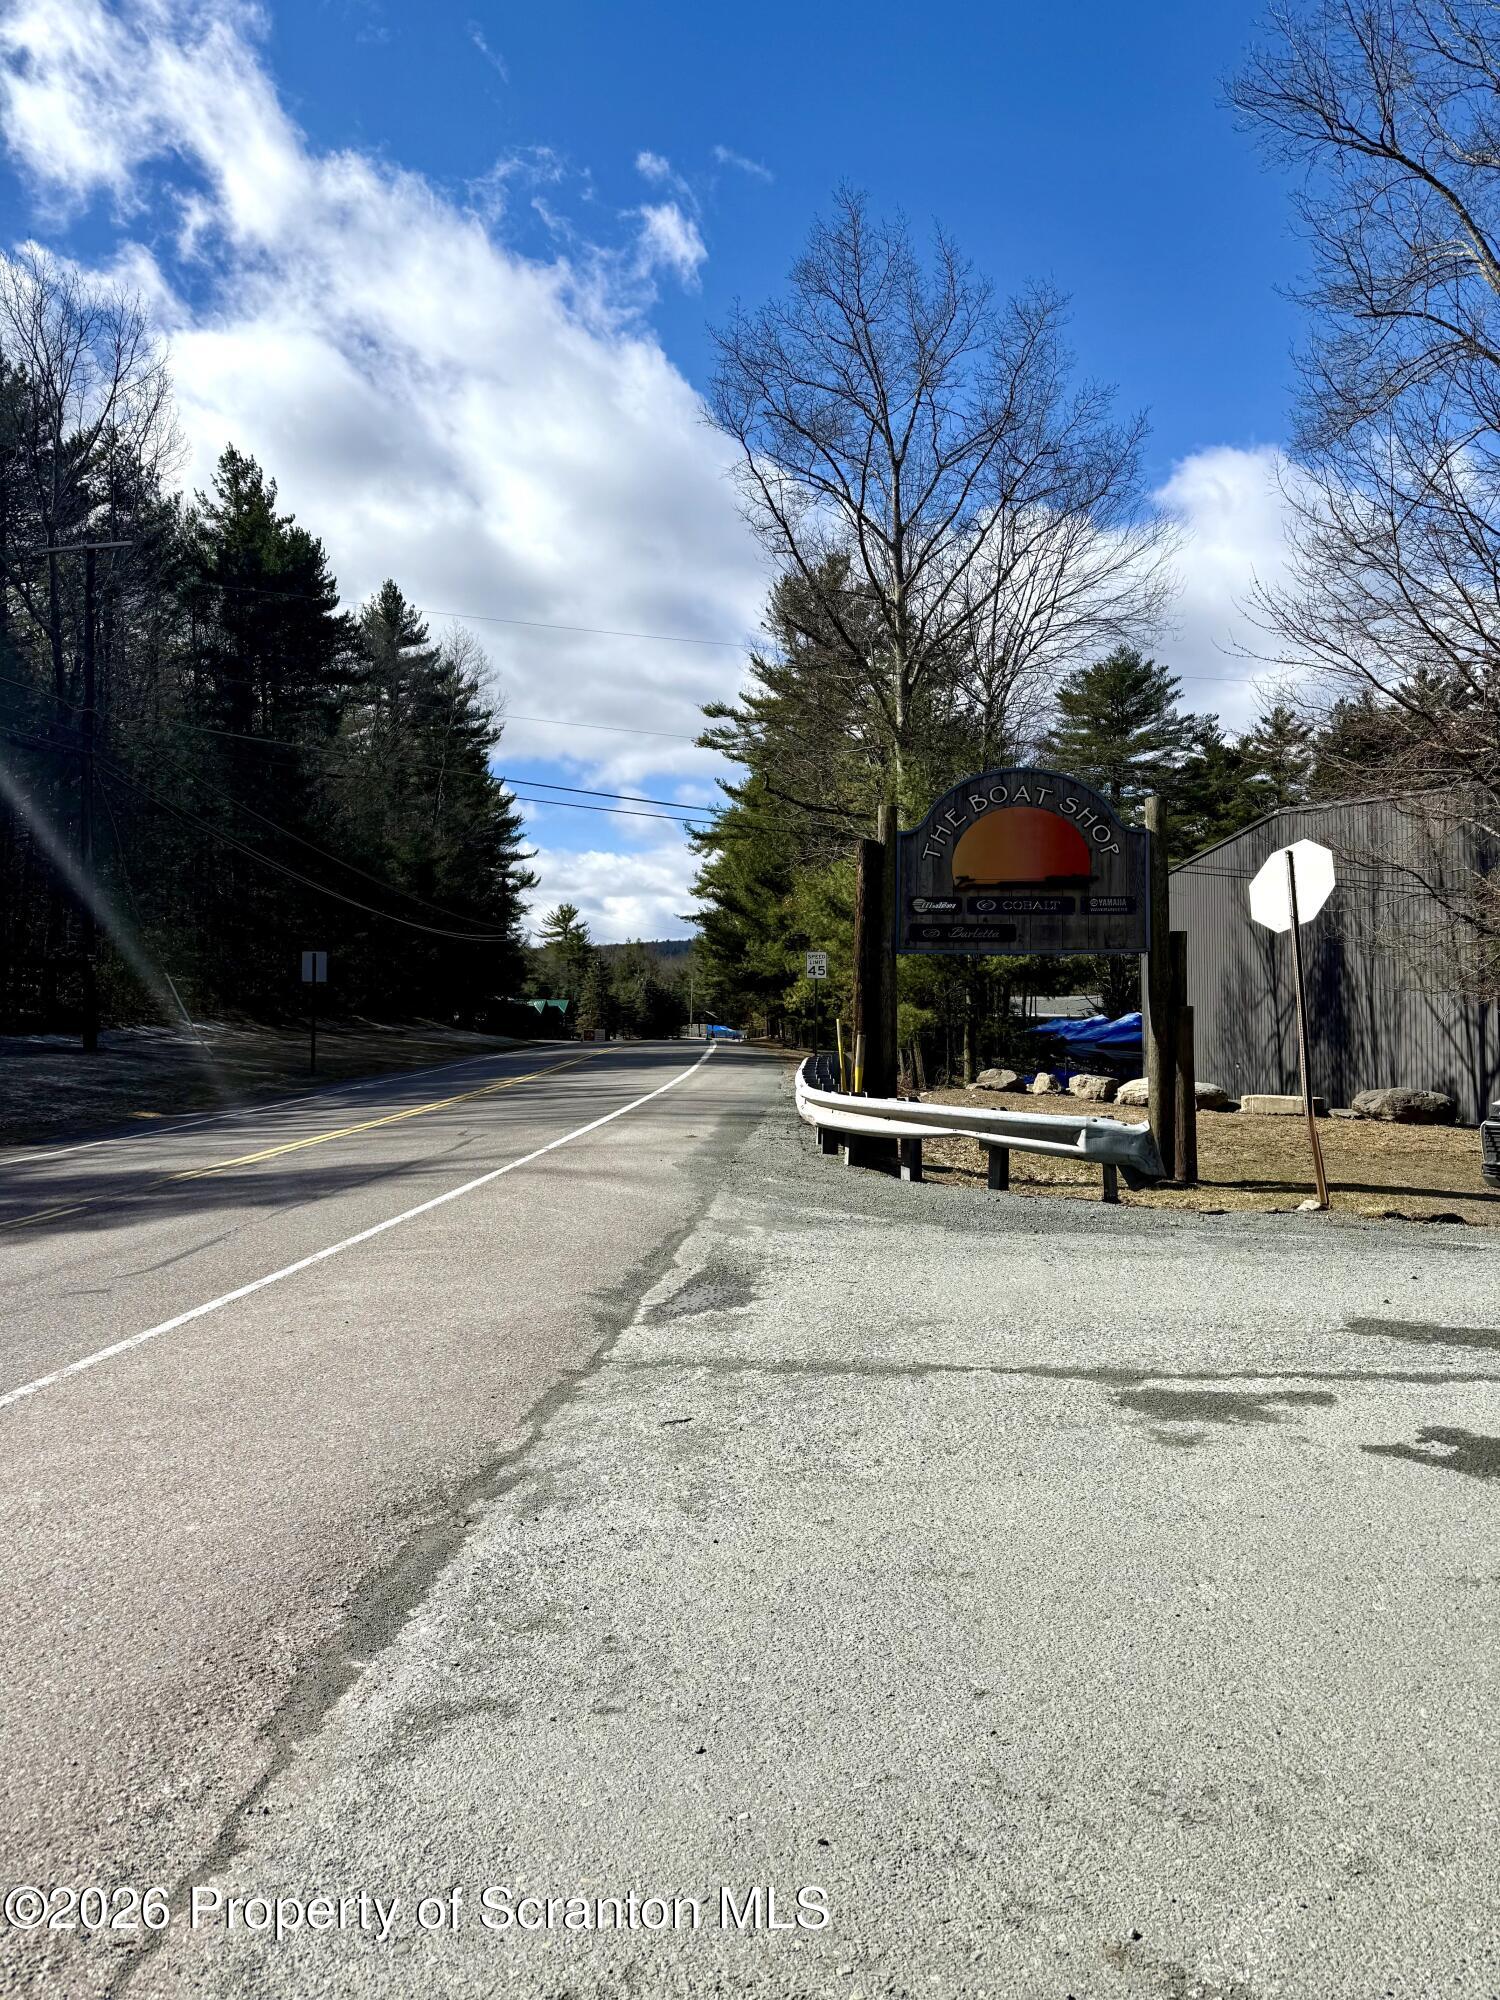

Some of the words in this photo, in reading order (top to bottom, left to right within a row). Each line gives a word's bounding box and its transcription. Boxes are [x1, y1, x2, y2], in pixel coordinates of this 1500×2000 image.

[922, 807, 967, 862] THE
[968, 785, 1054, 813] BOAT
[1059, 797, 1120, 857] SHOP
[1002, 900, 1061, 910] COBALT
[1099, 898, 1127, 906] YAMAHA
[807, 965, 826, 976] 45
